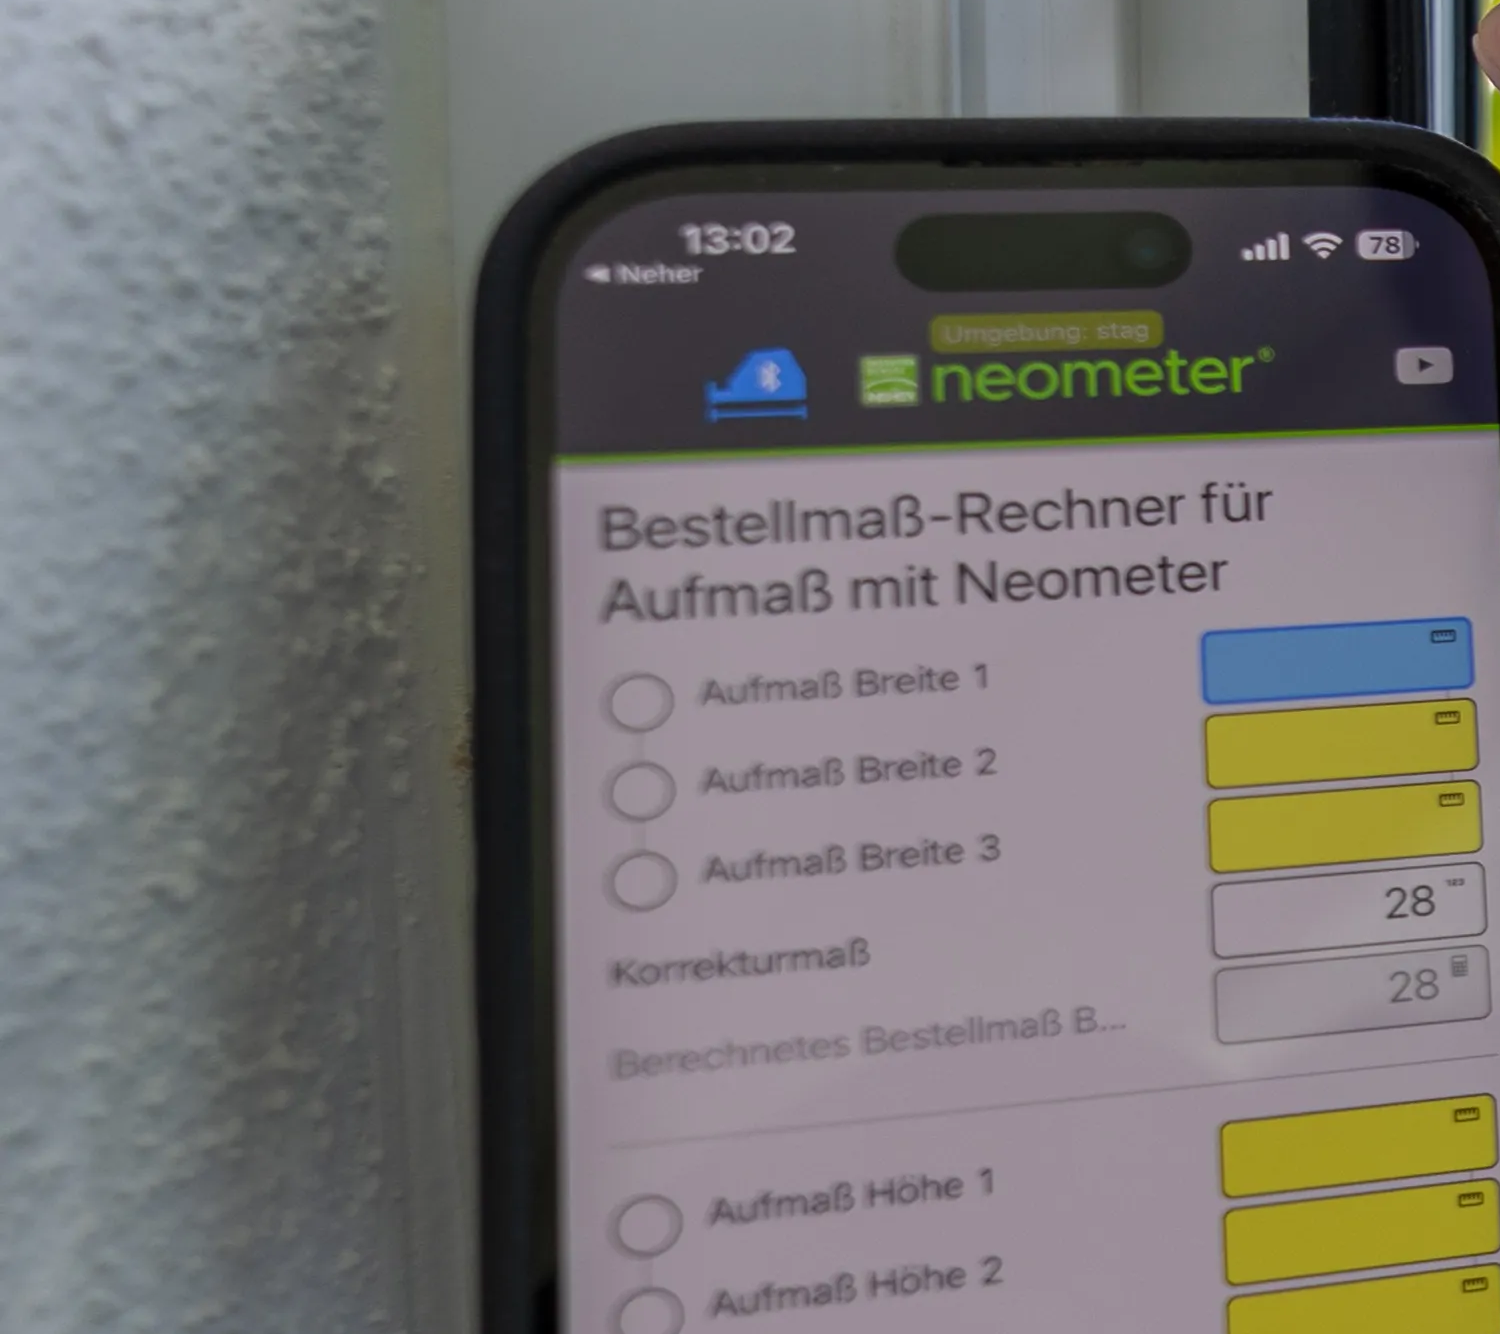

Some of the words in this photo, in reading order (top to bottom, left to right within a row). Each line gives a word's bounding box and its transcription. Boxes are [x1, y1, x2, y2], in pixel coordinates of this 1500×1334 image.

[678, 221, 796, 255] 13:02
[1370, 236, 1401, 254] 78
[615, 263, 704, 284] Neher
[943, 323, 1088, 344] Umgebung:
[1097, 323, 1150, 342] stag
[600, 487, 1186, 553] Bestellmaß-Rechner
[1201, 482, 1273, 523] für
[600, 568, 833, 624] Aufmaß
[850, 564, 939, 611] mit
[956, 556, 1230, 606] Neometer
[699, 669, 843, 707] Aufmaß
[853, 666, 960, 698] Breite
[974, 663, 988, 689] 1
[700, 757, 845, 795] Aufmaß
[856, 752, 962, 784] Breite
[975, 748, 998, 777] 2
[702, 844, 846, 884] Aufmaß
[859, 839, 965, 872] Breite
[979, 834, 1001, 863] 3
[1385, 885, 1436, 919] 28
[608, 937, 871, 988] Korrekturmaß
[1389, 968, 1439, 1003] 28
[610, 1031, 852, 1080] Berechnetes
[860, 1009, 1062, 1056] Bestellmaß
[708, 1182, 855, 1228] Aufmaß
[866, 1174, 964, 1208] Höhe
[978, 1168, 993, 1196] 1
[710, 1272, 857, 1319] Aufmaß
[867, 1264, 967, 1300] Höhe
[981, 1256, 1003, 1286] 2
